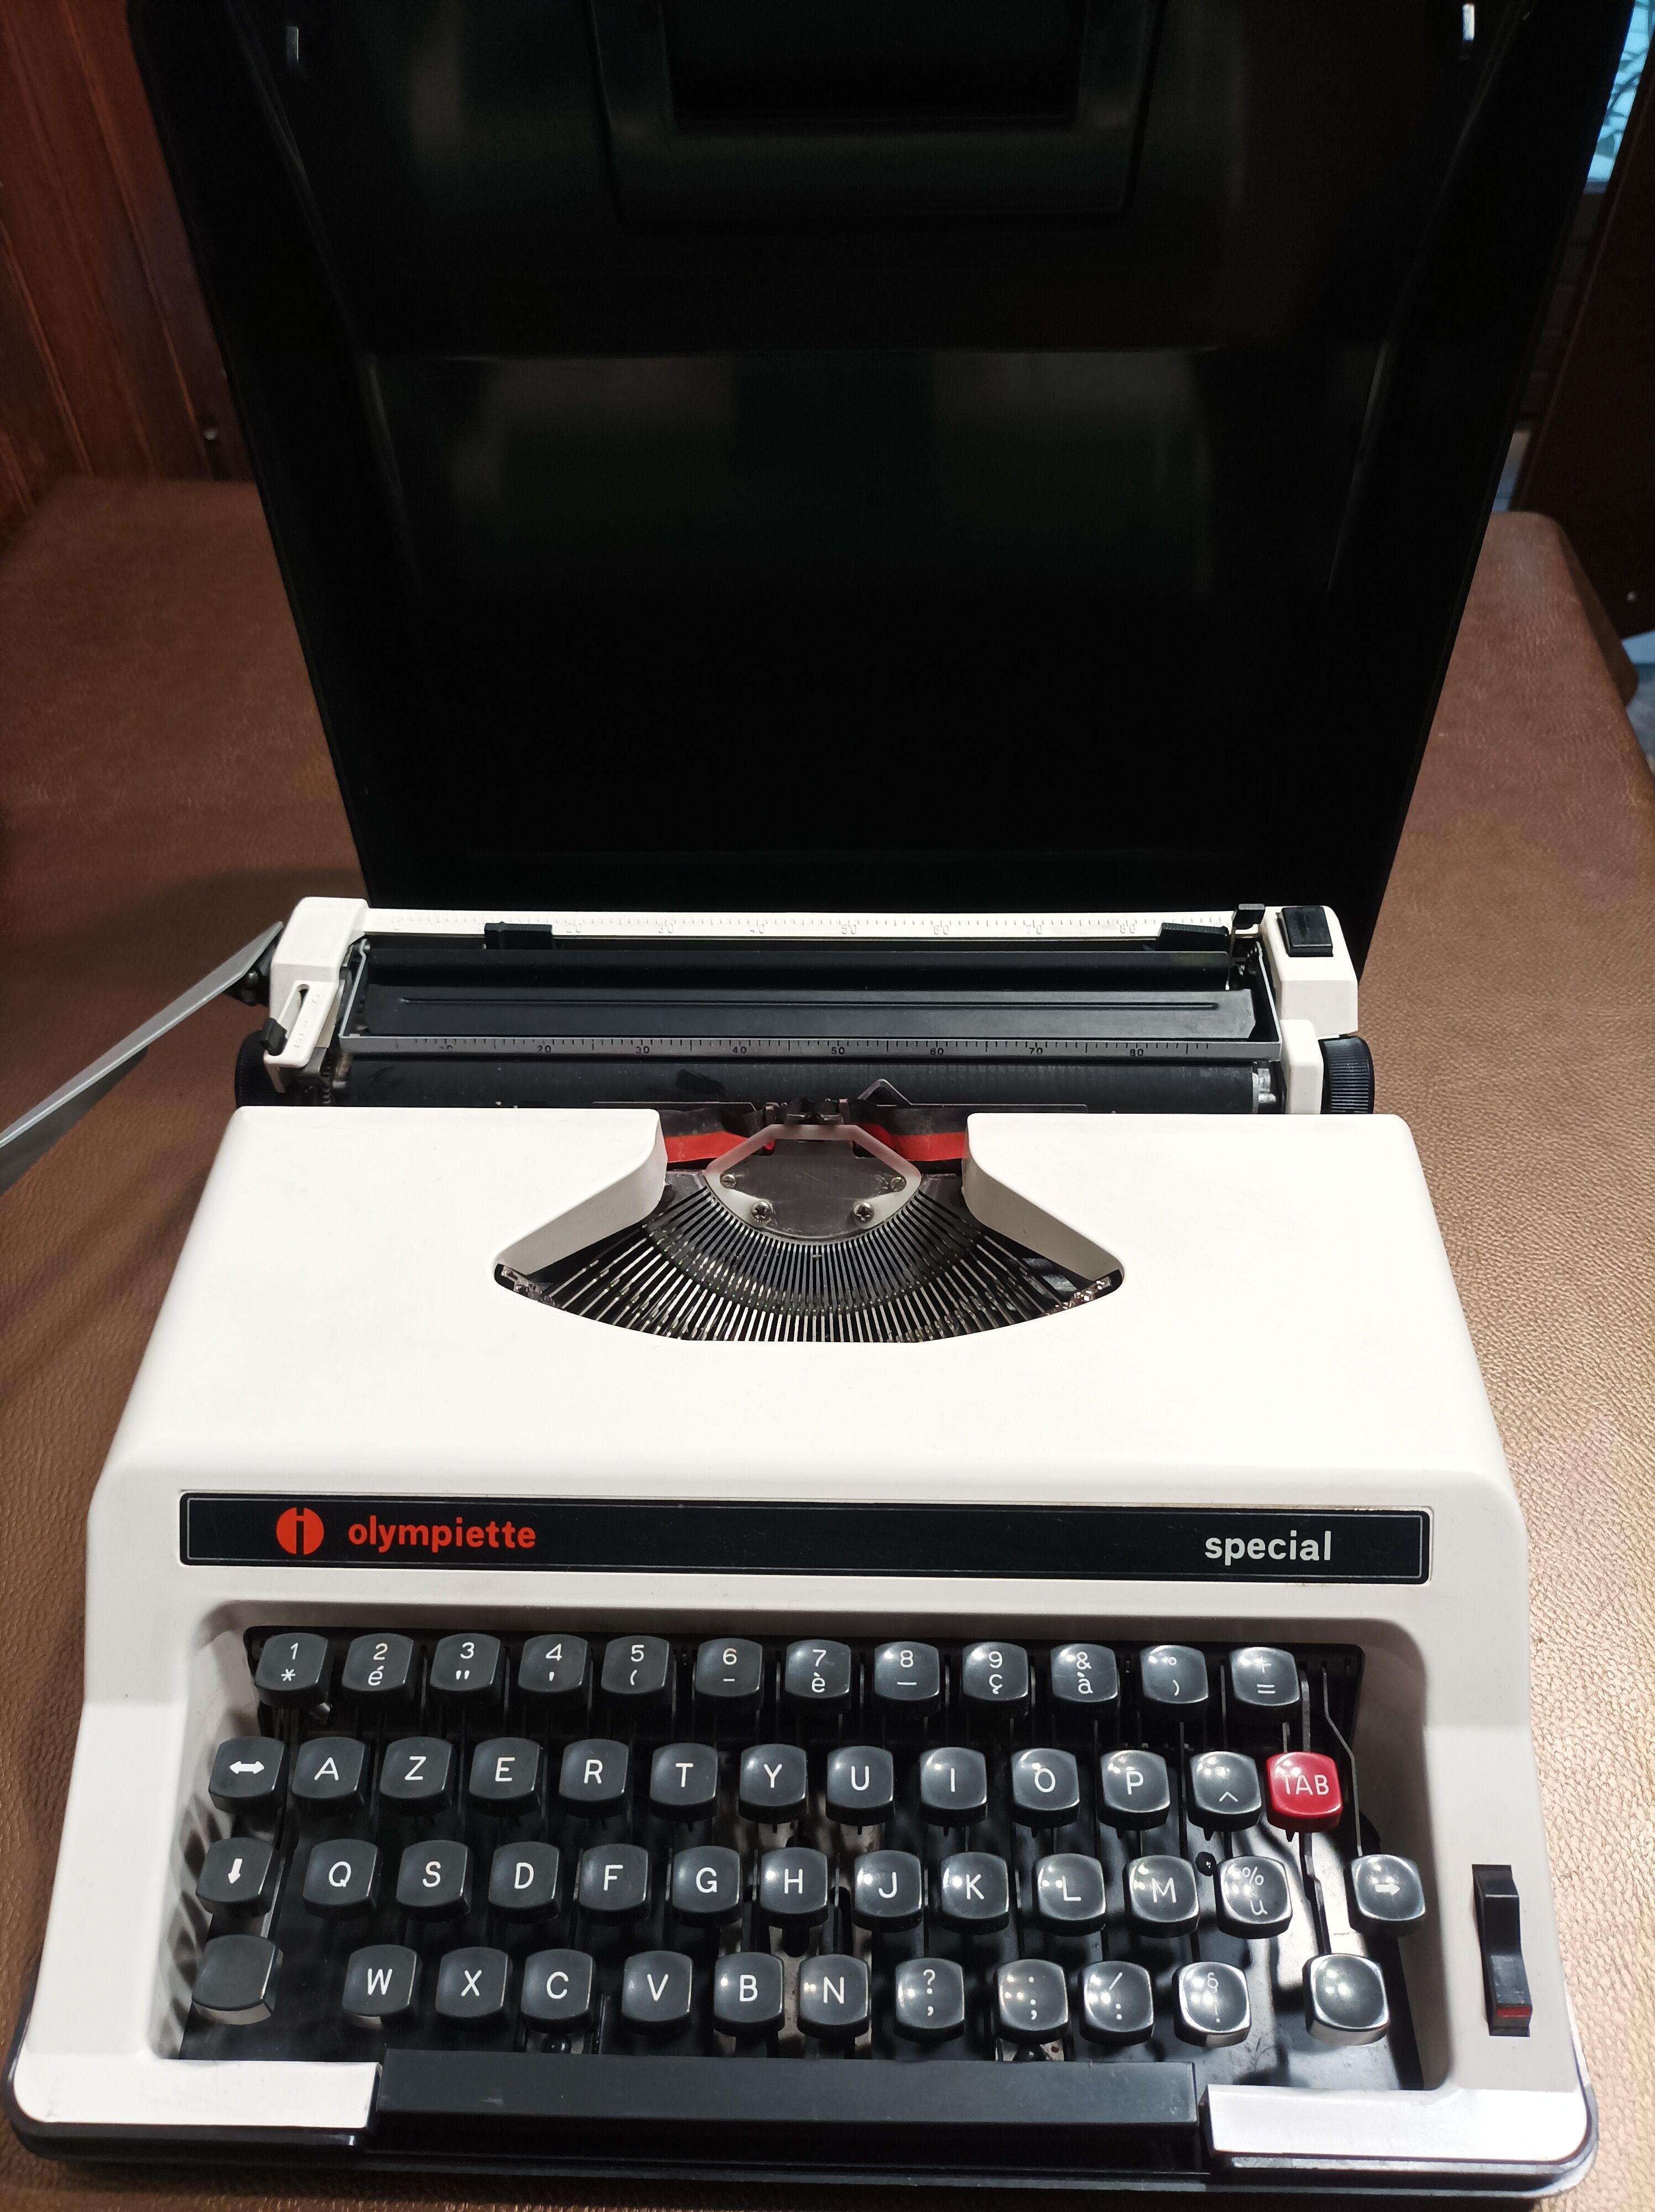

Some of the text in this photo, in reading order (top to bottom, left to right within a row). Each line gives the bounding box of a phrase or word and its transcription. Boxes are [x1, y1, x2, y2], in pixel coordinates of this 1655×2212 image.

[636, 1046, 650, 1054] 30
[930, 1047, 944, 1056] 60
[1029, 1047, 1043, 1055] 70
[1129, 1048, 1144, 1057] 80
[348, 1515, 535, 1553] olympiette
[1205, 1530, 1331, 1566] special
[291, 1643, 298, 1660] 1
[373, 1643, 387, 1660] 2
[461, 1642, 474, 1658] 3
[546, 1644, 562, 1661] 4
[631, 1645, 644, 1662] 5
[723, 1648, 737, 1665] 6
[813, 1649, 826, 1666] 7
[899, 1650, 913, 1667] 8
[988, 1651, 1002, 1668] 9
[1076, 1651, 1091, 1670] &
[368, 1666, 384, 1686] é
[812, 1672, 825, 1692] è
[989, 1674, 1002, 1694] ç
[1077, 1672, 1093, 1694] à
[315, 1757, 339, 1780] A
[405, 1756, 426, 1780] Z
[495, 1757, 515, 1781] E
[584, 1760, 602, 1783] R
[676, 1763, 693, 1787] T
[764, 1764, 782, 1788] Y
[851, 1766, 869, 1790] U
[951, 1768, 955, 1792] I
[1034, 1767, 1056, 1792] O
[1126, 1771, 1144, 1794] P
[1282, 1774, 1329, 1796] TAB
[329, 1861, 351, 1887] Q
[423, 1861, 440, 1887] S
[514, 1863, 534, 1888] D
[604, 1865, 623, 1890] F
[696, 1867, 717, 1893] G
[784, 1869, 803, 1893] H
[878, 1871, 897, 1898] J
[1242, 1866, 1264, 1886] %
[965, 1874, 984, 1899] K
[1063, 1875, 1081, 1901] L
[1152, 1877, 1177, 1903] M
[368, 1969, 392, 1995] W
[461, 1970, 482, 1996] X
[547, 1971, 568, 1999] C
[647, 1974, 668, 2001] V
[740, 1975, 757, 2001] B
[824, 1976, 844, 2004] N
[923, 1969, 935, 1994] ?
